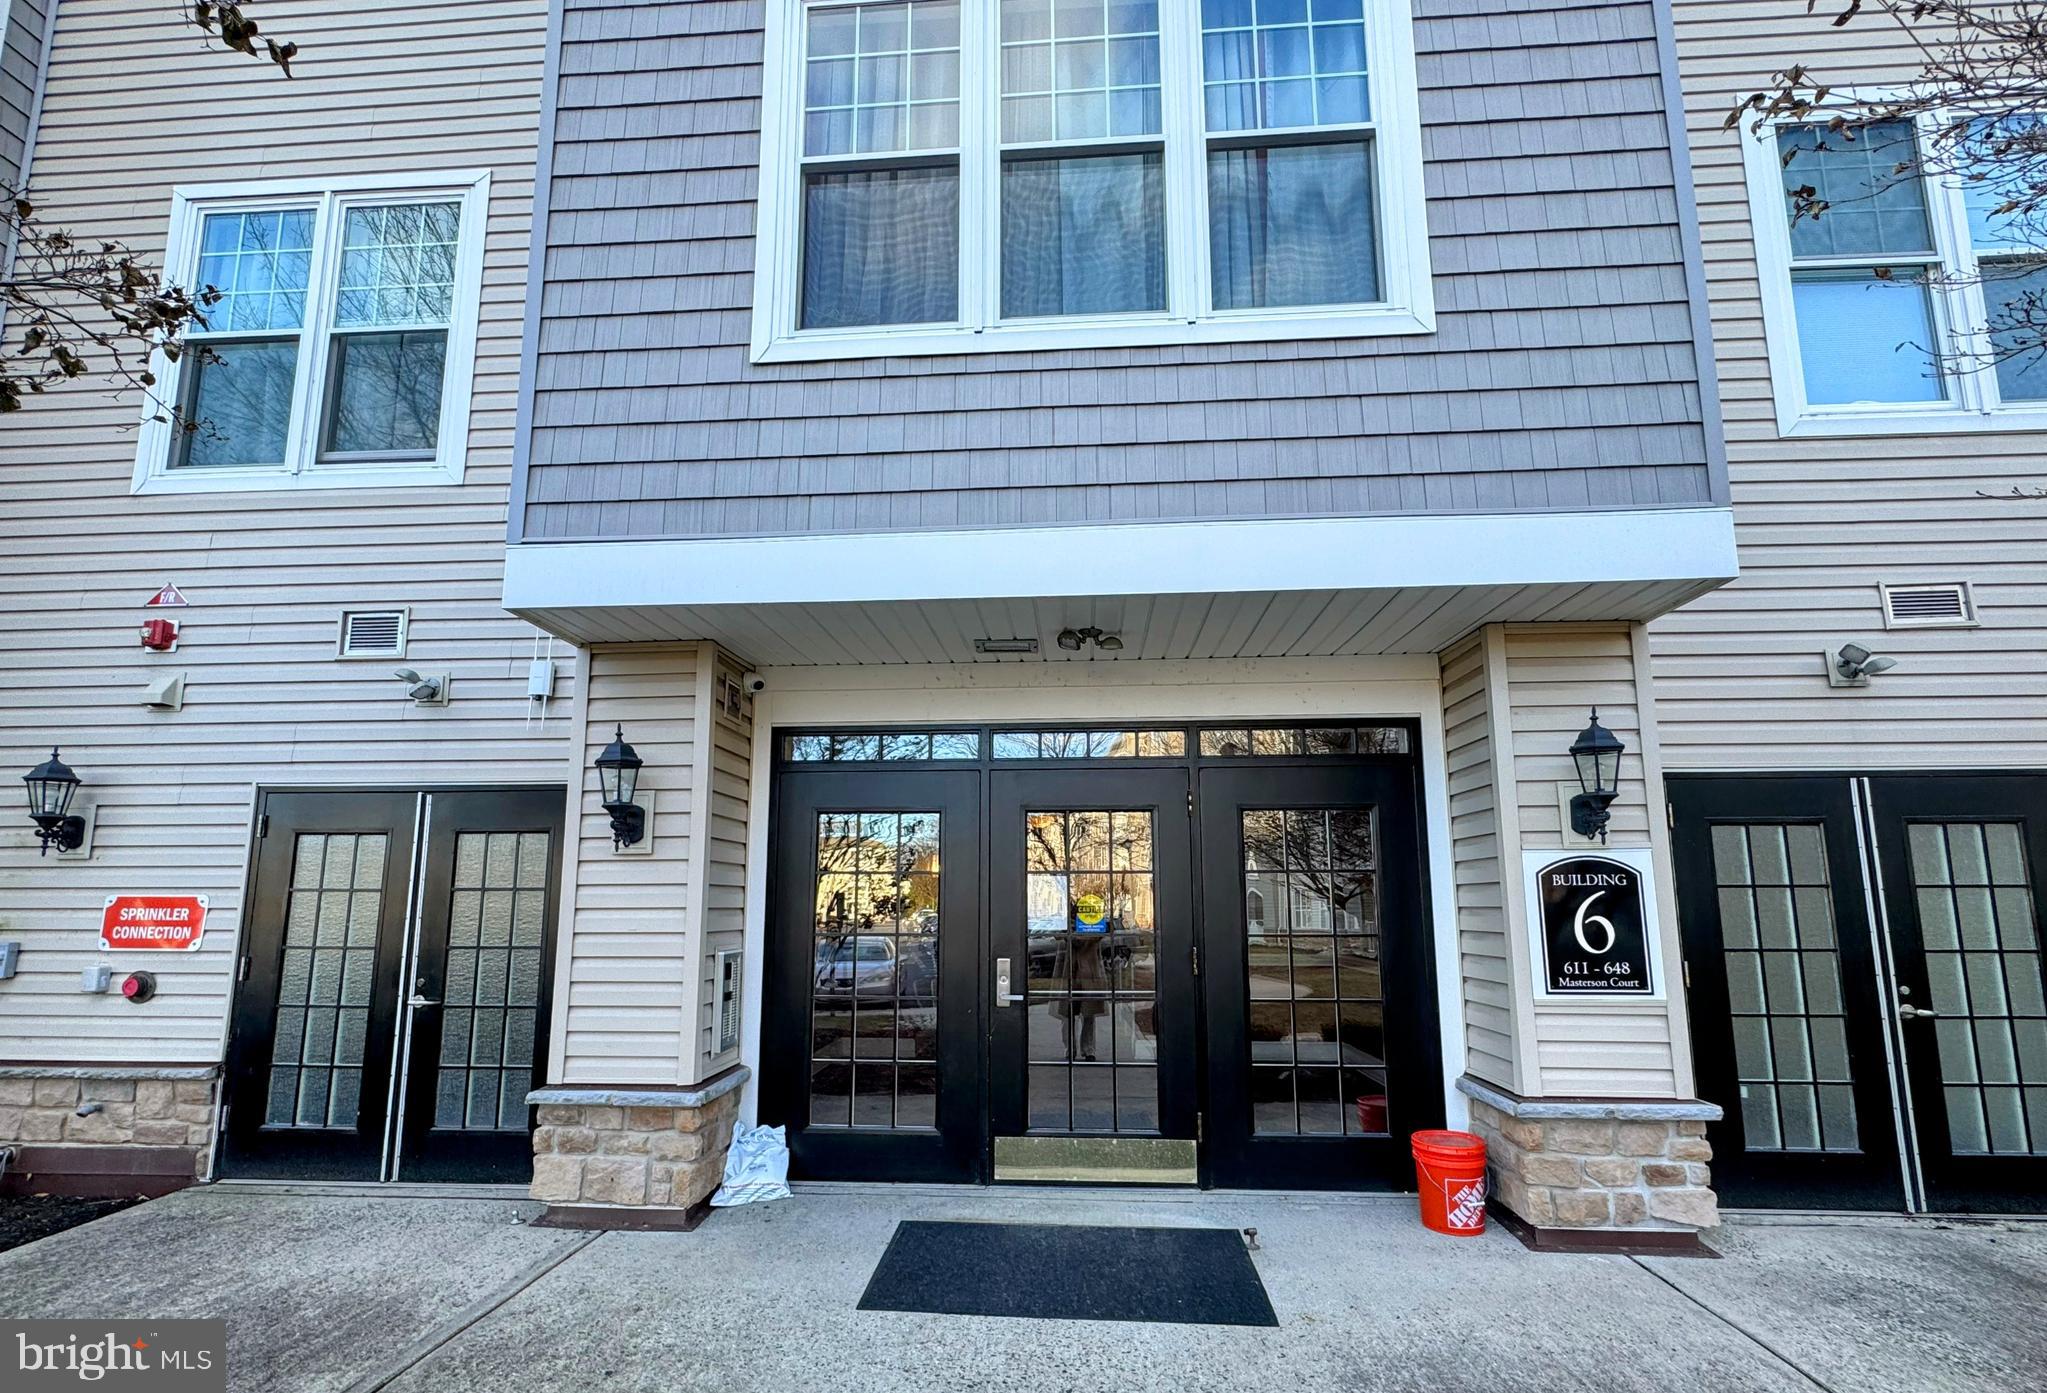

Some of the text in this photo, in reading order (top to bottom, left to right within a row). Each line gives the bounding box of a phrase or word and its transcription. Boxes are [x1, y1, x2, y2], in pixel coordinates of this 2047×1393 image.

[159, 591, 176, 603] F/R
[1553, 874, 1627, 886] BUILDING
[120, 907, 190, 921] SPRINKLER
[1574, 890, 1616, 954] 6
[112, 926, 192, 939] CONNECTION
[1564, 961, 1589, 975] 611
[1604, 961, 1631, 975] 648
[1559, 977, 1640, 987] Masterson Court
[1452, 1184, 1472, 1205] THE
[1467, 1206, 1483, 1228] DEP
